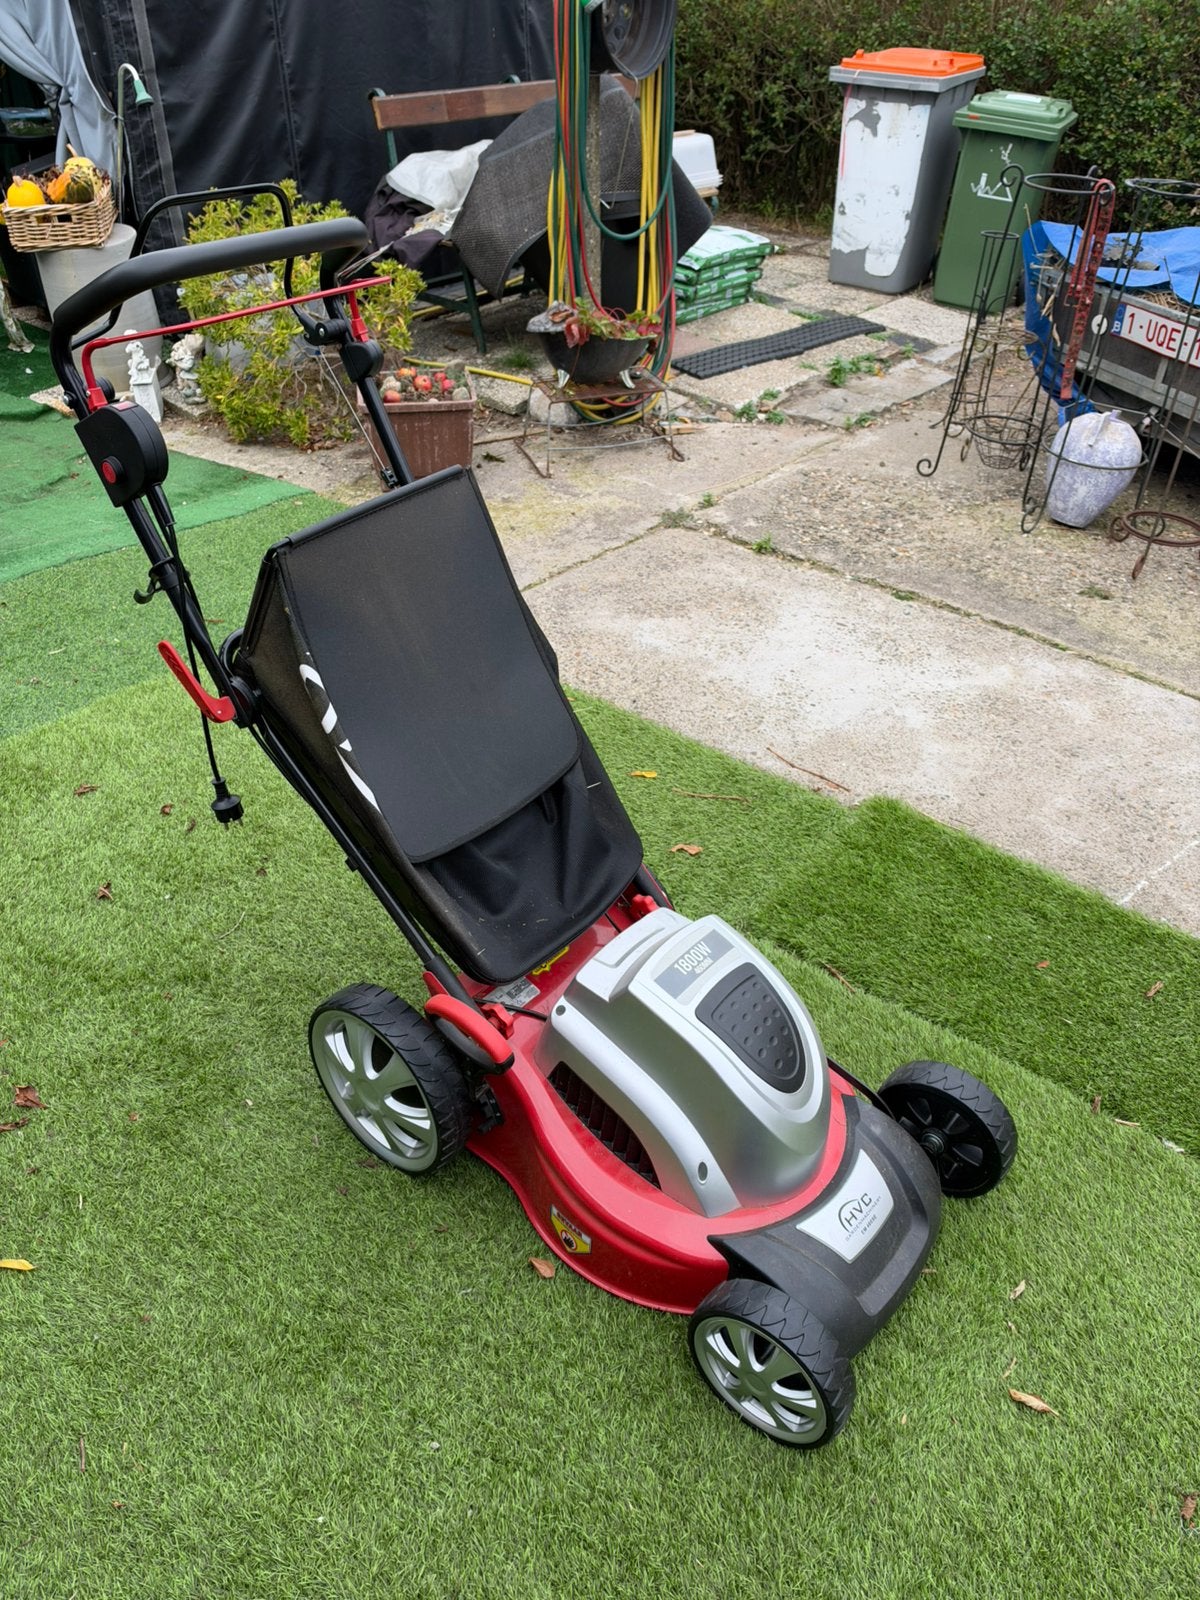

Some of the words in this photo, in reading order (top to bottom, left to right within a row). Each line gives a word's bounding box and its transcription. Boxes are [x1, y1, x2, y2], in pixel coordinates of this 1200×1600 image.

[1111, 320, 1121, 333] B
[673, 940, 712, 975] 1800W
[844, 1192, 872, 1227] HVC
